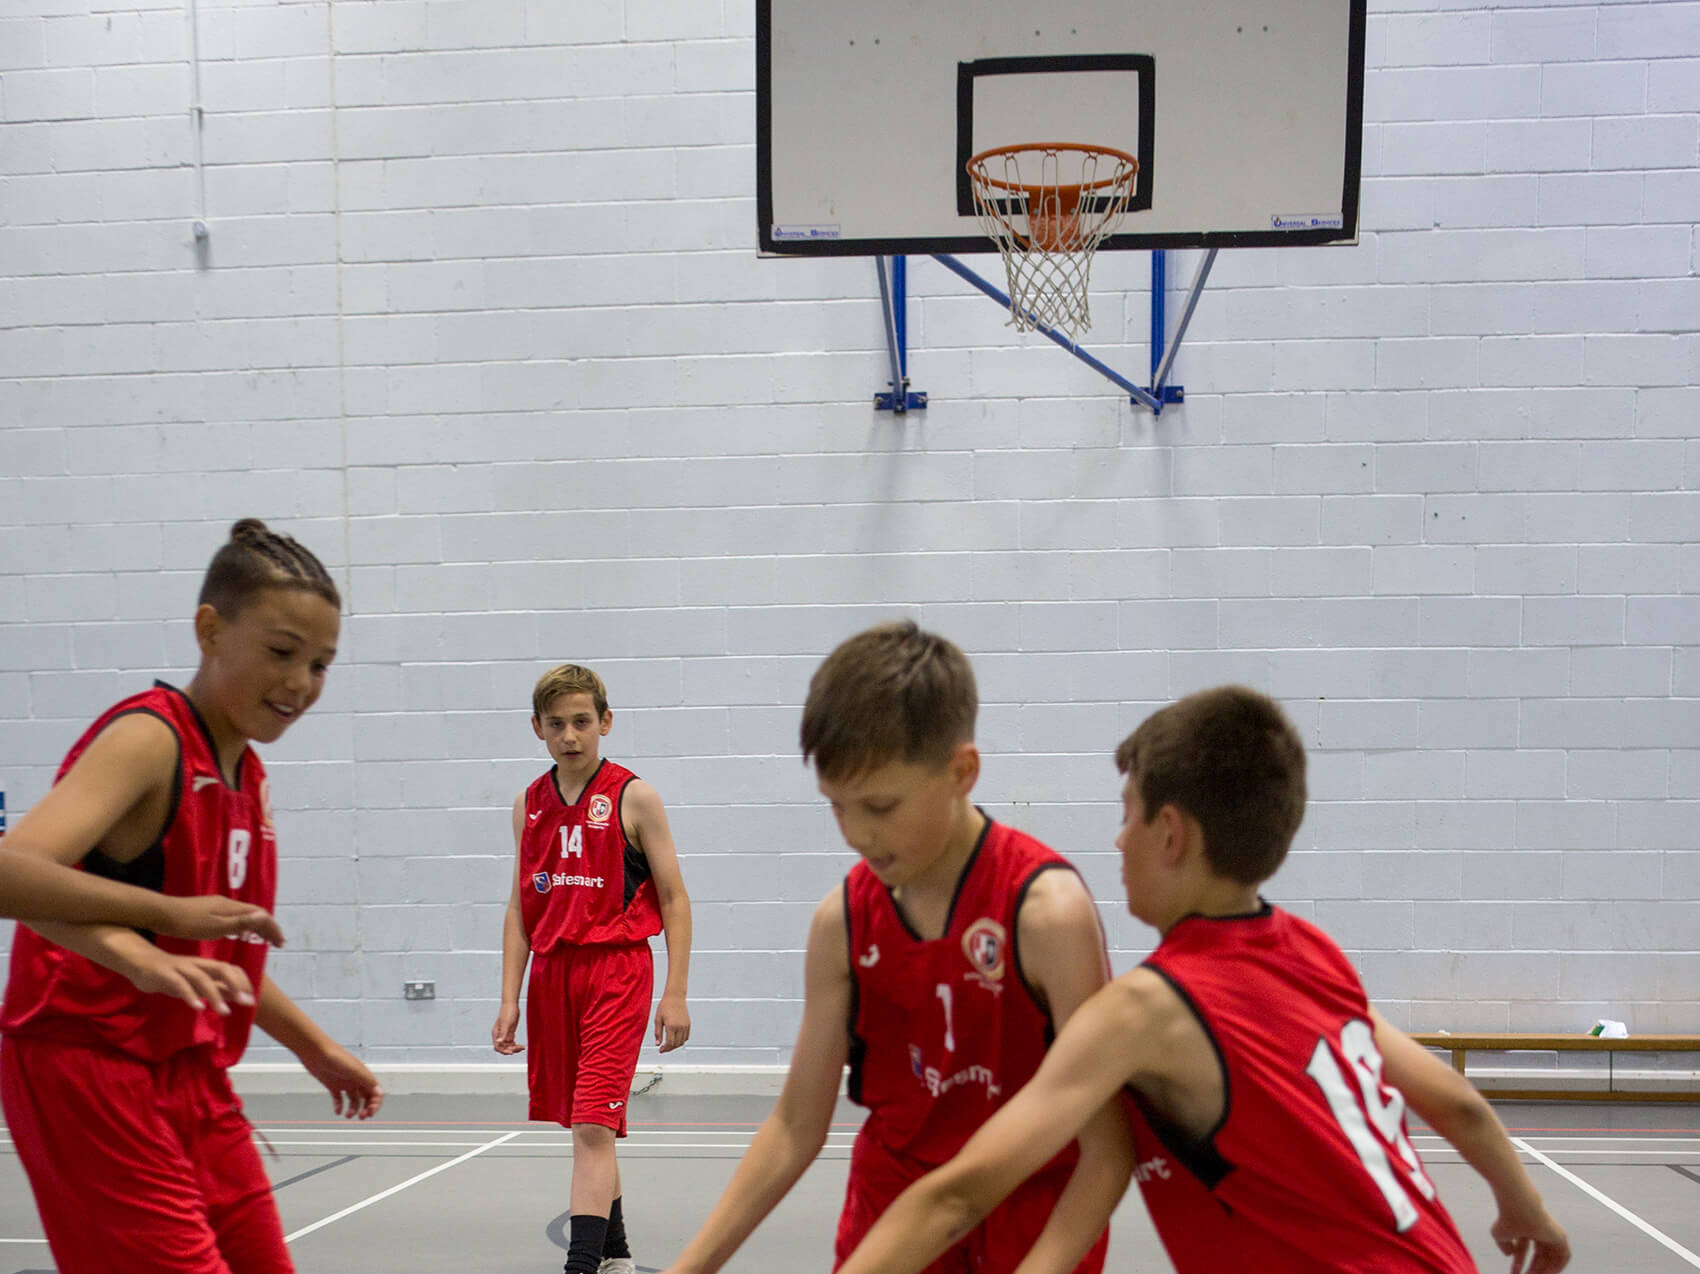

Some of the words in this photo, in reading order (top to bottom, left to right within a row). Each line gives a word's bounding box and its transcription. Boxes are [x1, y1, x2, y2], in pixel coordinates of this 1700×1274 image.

[228, 828, 251, 890] 8
[559, 825, 582, 858] 14
[936, 983, 955, 1052] 1
